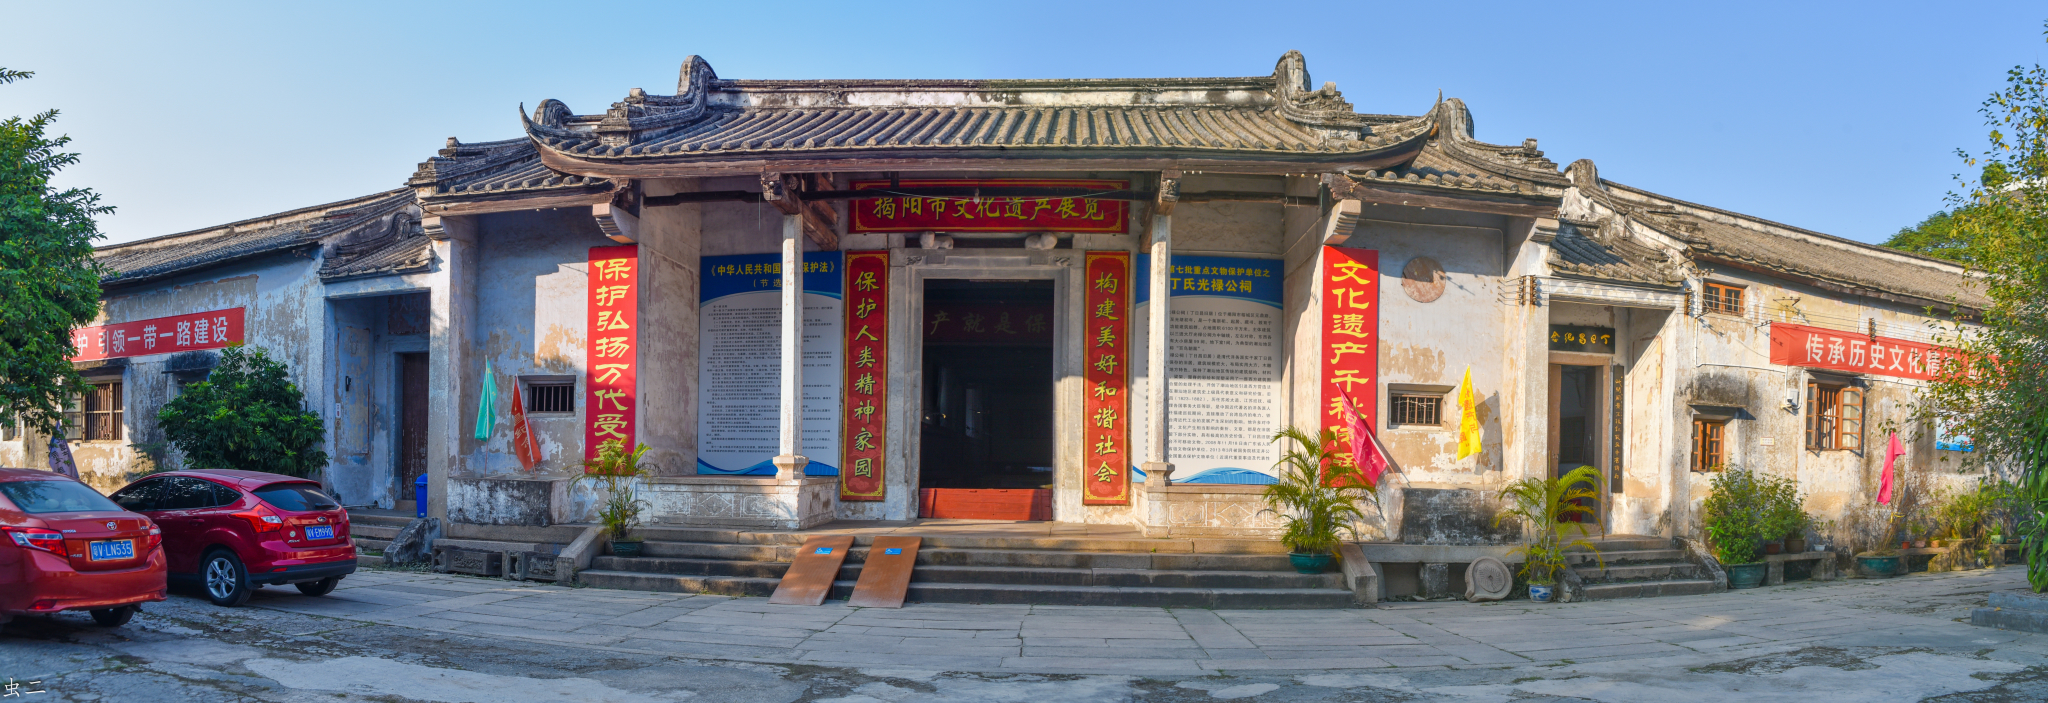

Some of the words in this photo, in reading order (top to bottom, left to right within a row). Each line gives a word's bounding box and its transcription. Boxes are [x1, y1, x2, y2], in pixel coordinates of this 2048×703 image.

[872, 196, 1105, 222] 揭阳市文化遗产展览
[711, 261, 835, 276] 《中华人民共和国保护法》
[1170, 277, 1252, 293] 丁氏光禄公祠
[98, 316, 228, 355] 引领一带一路建设
[853, 270, 881, 479] 保护人类精神家园
[1094, 270, 1119, 484] 构建美好和谐社会
